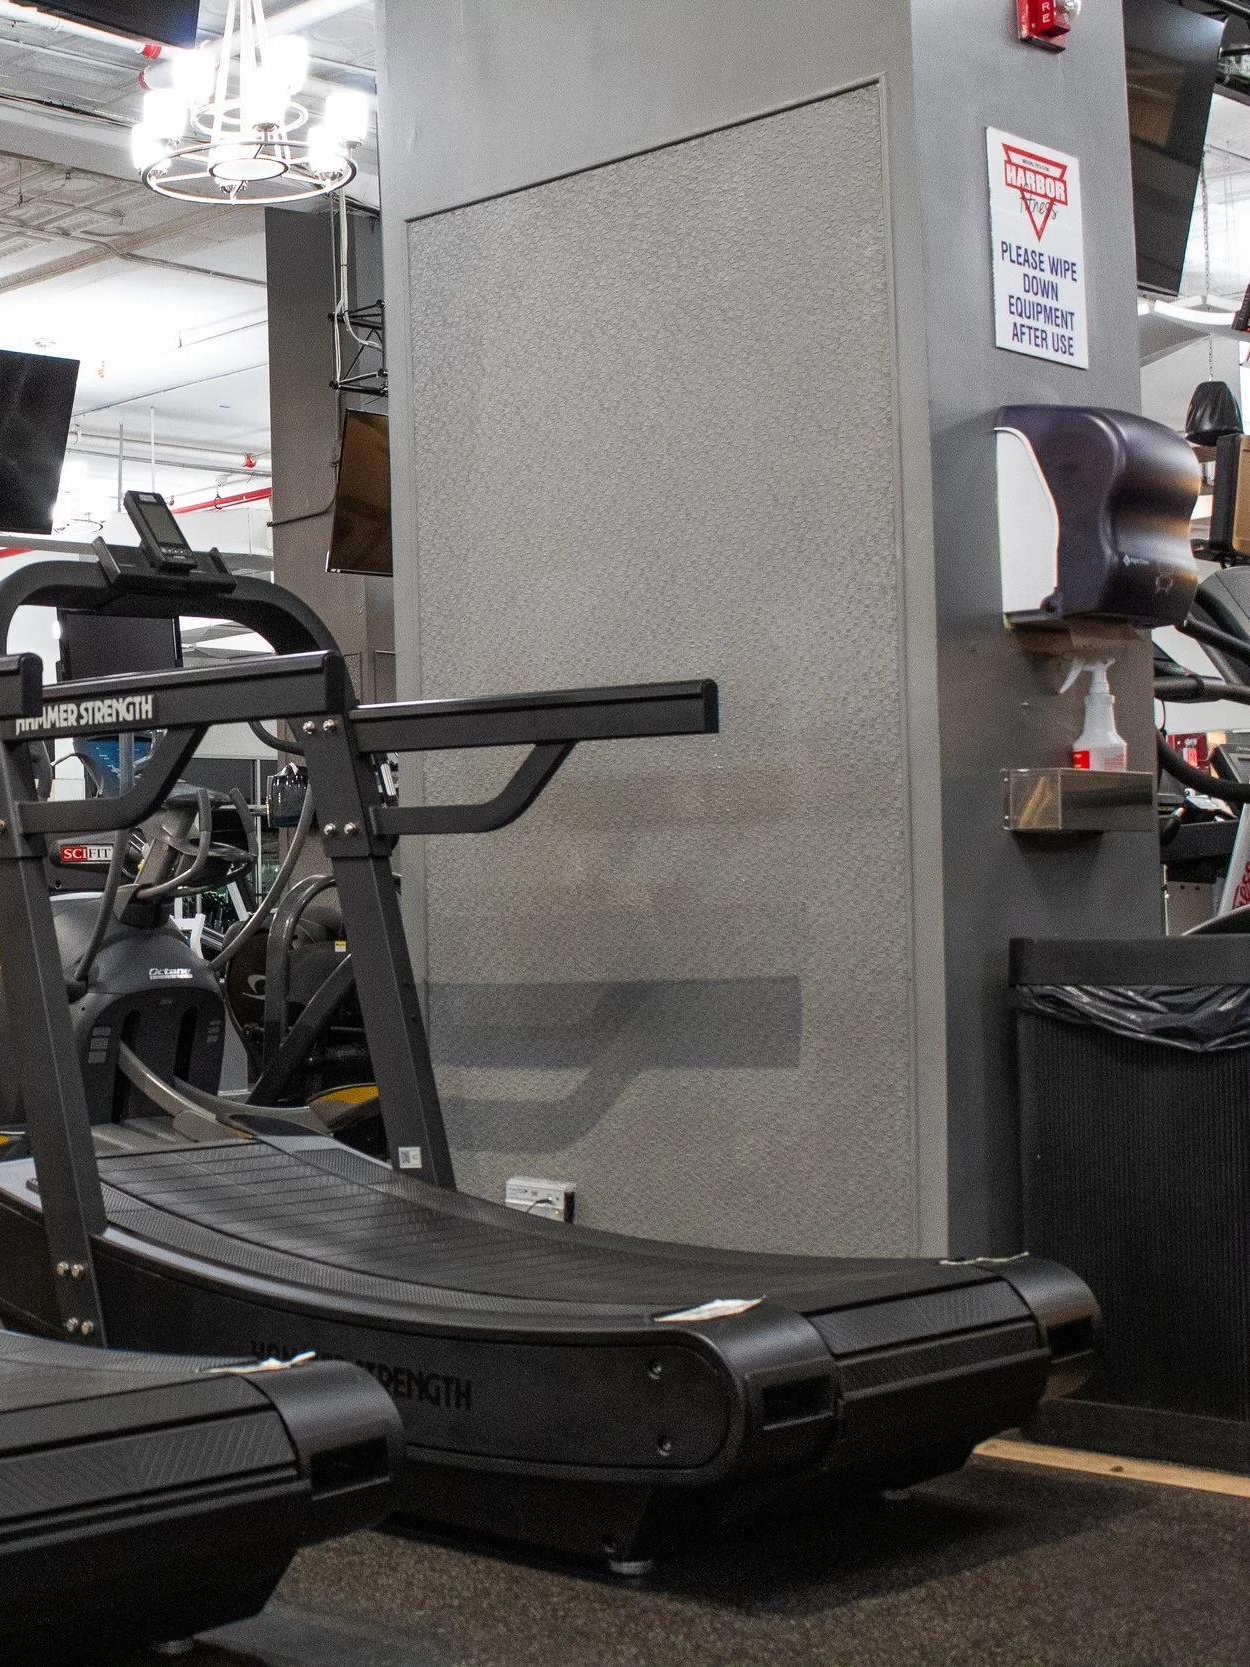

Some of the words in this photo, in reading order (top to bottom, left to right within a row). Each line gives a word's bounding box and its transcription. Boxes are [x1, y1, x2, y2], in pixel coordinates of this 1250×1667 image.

[1006, 163, 1065, 202] HARBOR
[1001, 240, 1045, 273] PLEASE
[1048, 254, 1078, 282] WIPE
[1023, 273, 1059, 302] DOWN
[1008, 294, 1075, 332] EQUIPMENT
[1012, 321, 1049, 350] AFTER
[1051, 331, 1075, 357] USE
[79, 694, 154, 726] STRENGTH
